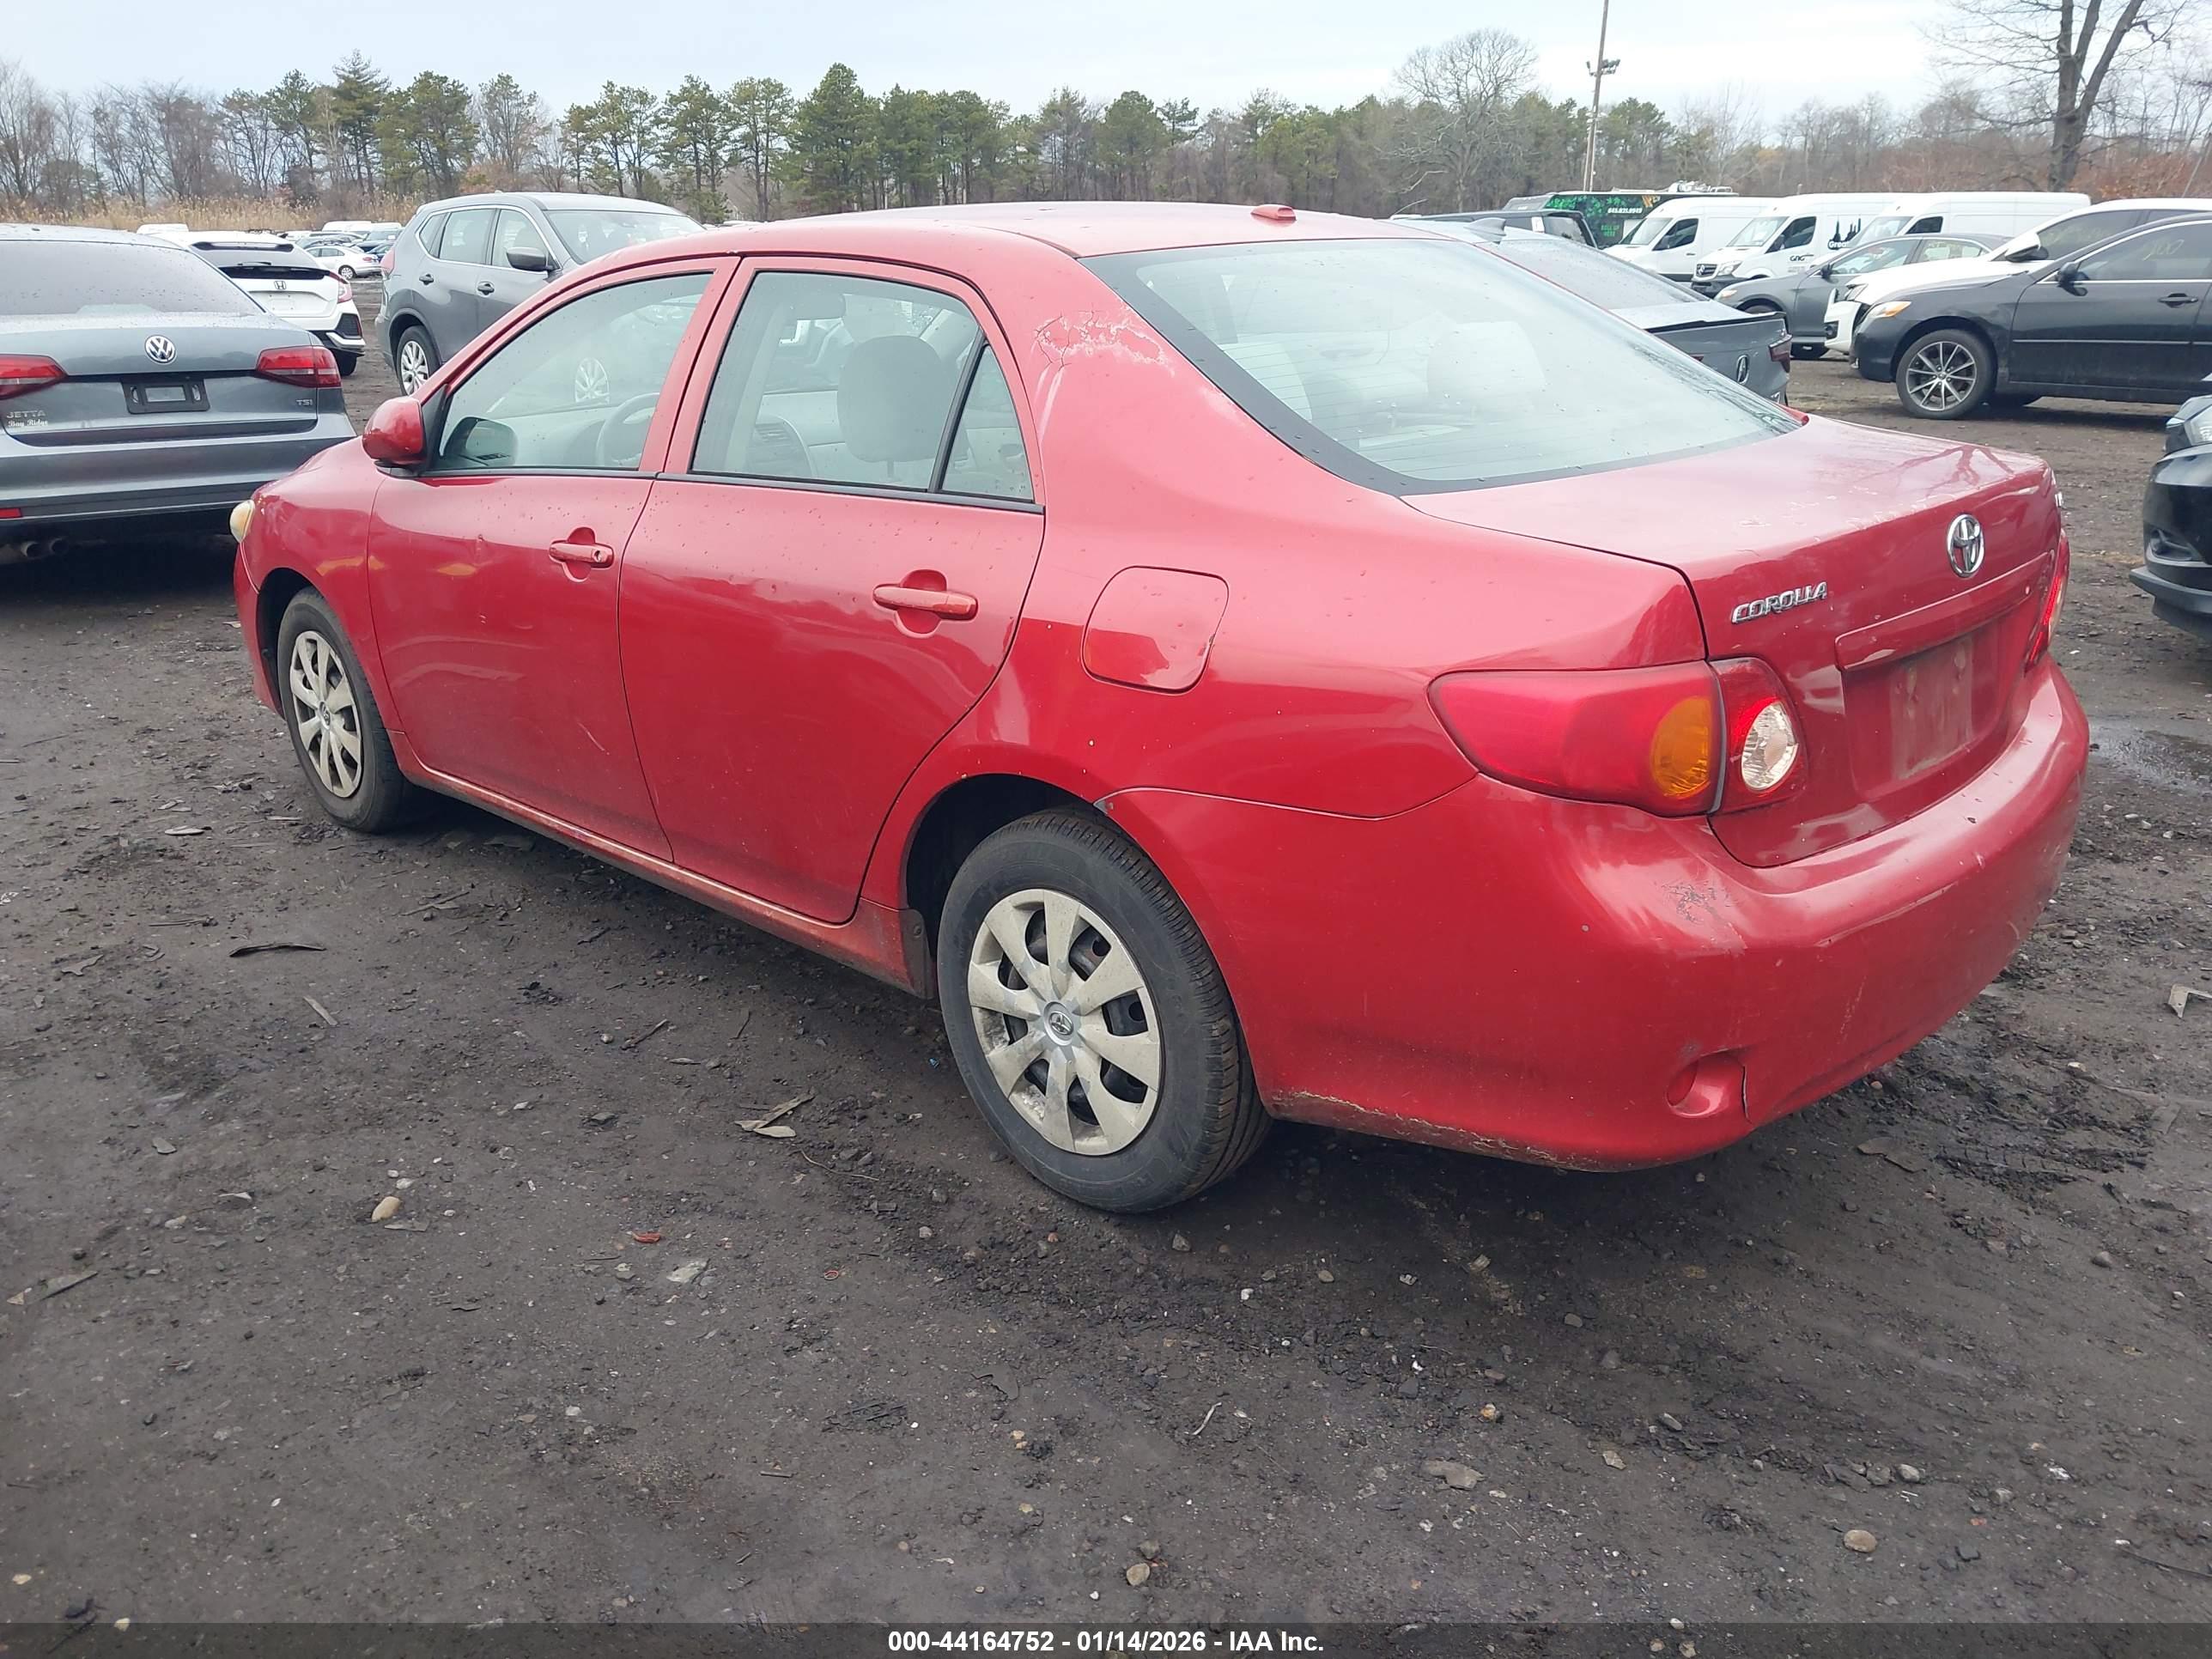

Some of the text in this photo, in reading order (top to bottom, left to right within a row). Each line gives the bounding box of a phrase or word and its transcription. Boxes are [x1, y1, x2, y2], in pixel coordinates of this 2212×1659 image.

[8, 418, 49, 428] Bay Ridge
[1731, 581, 1827, 624] COROLLA
